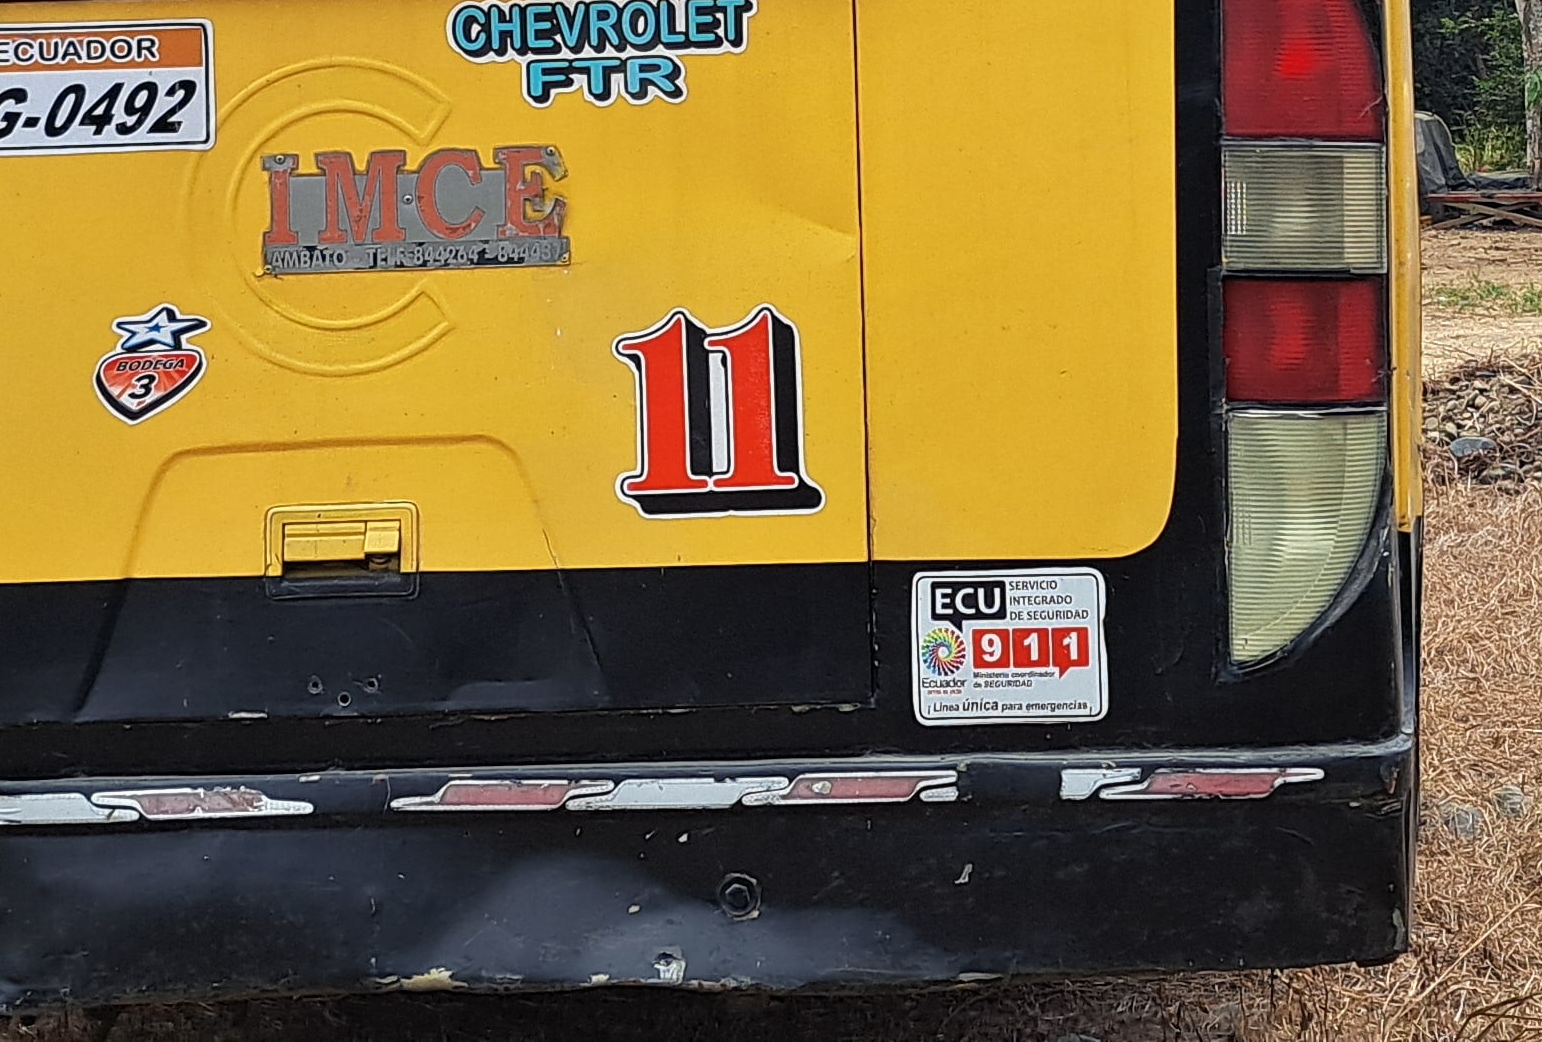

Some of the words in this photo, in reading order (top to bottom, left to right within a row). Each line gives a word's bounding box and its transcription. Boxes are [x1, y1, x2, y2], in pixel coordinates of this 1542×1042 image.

[527, 56, 683, 103] FTR
[272, 249, 346, 268] AMBATO
[116, 358, 186, 372] BODEGA
[127, 373, 157, 399] 3
[616, 306, 816, 511] 11
[1008, 580, 1058, 591] SERVICIO
[934, 586, 1002, 616] ECU
[1009, 594, 1073, 606] INTEGRADO
[1009, 610, 1024, 621] DE
[1026, 609, 1089, 621] SEGURIDAD
[922, 677, 967, 688] Ecuador
[962, 698, 999, 712] única
[1001, 702, 1023, 713] para
